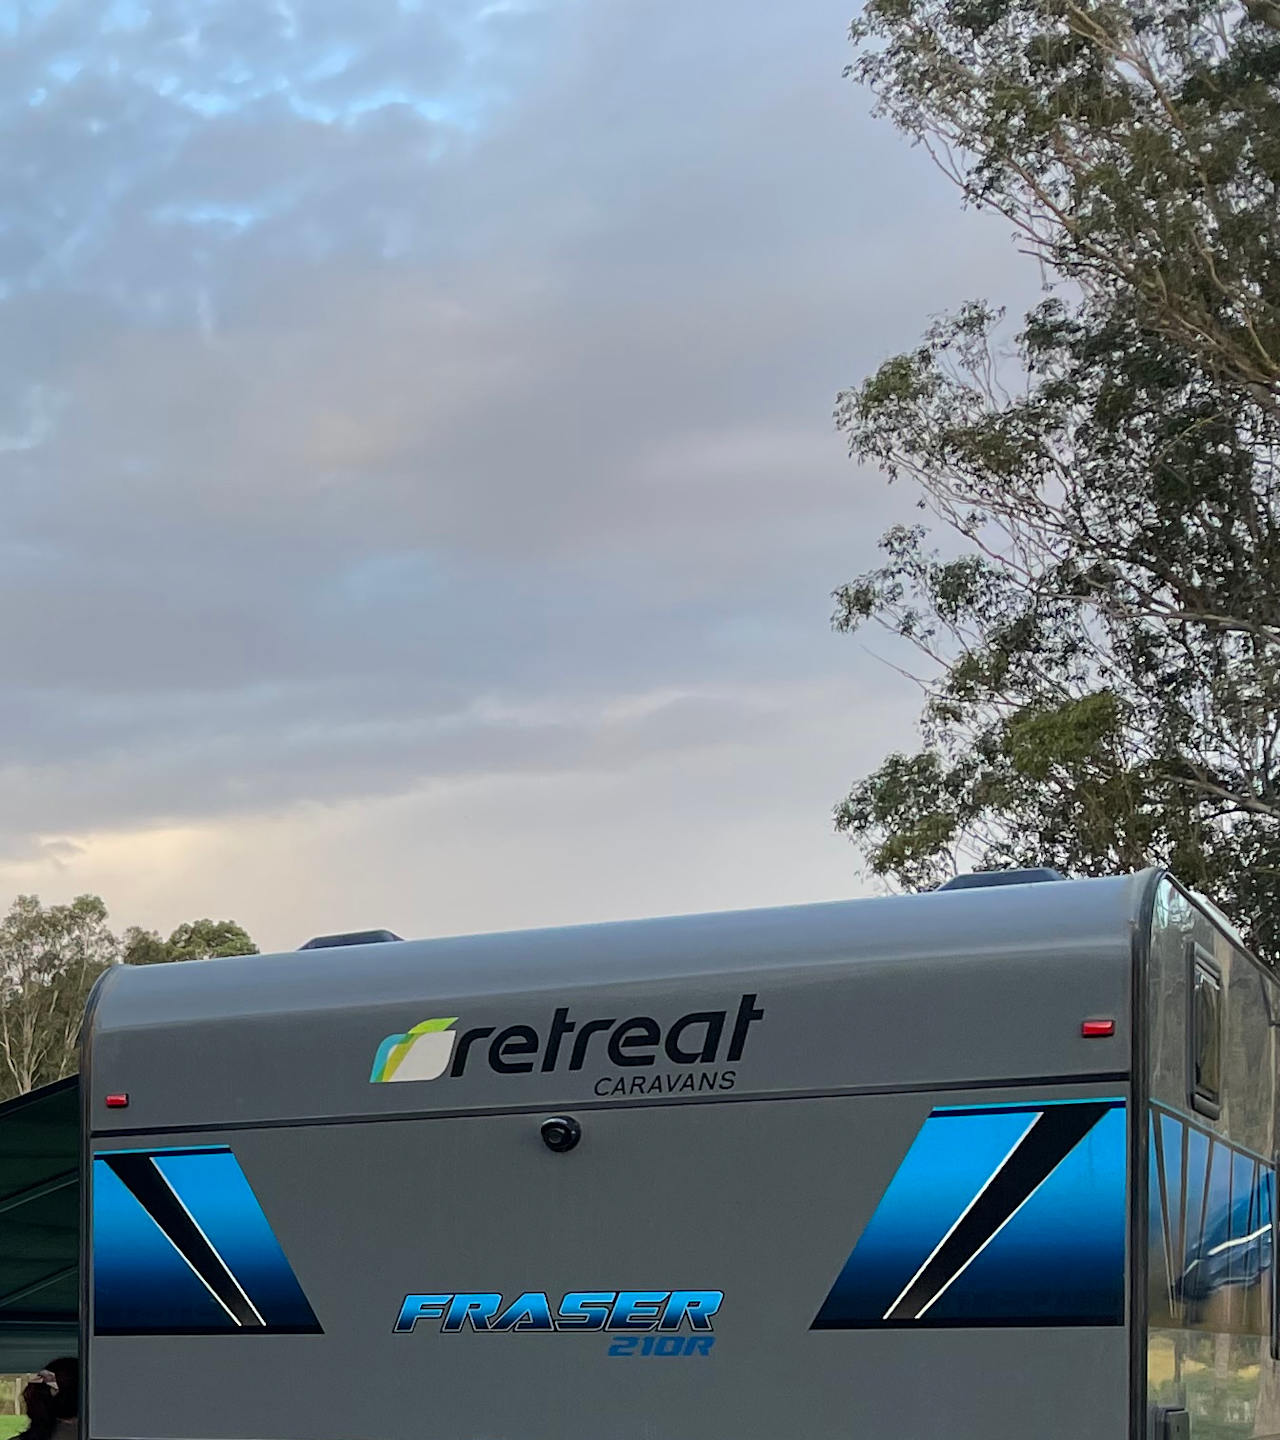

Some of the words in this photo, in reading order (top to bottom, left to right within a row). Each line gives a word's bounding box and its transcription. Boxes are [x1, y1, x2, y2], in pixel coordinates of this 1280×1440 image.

[449, 993, 764, 1078] retreat
[593, 1070, 737, 1097] CARAVANS
[392, 1290, 725, 1333] FRASER
[607, 1336, 717, 1357] 210R
